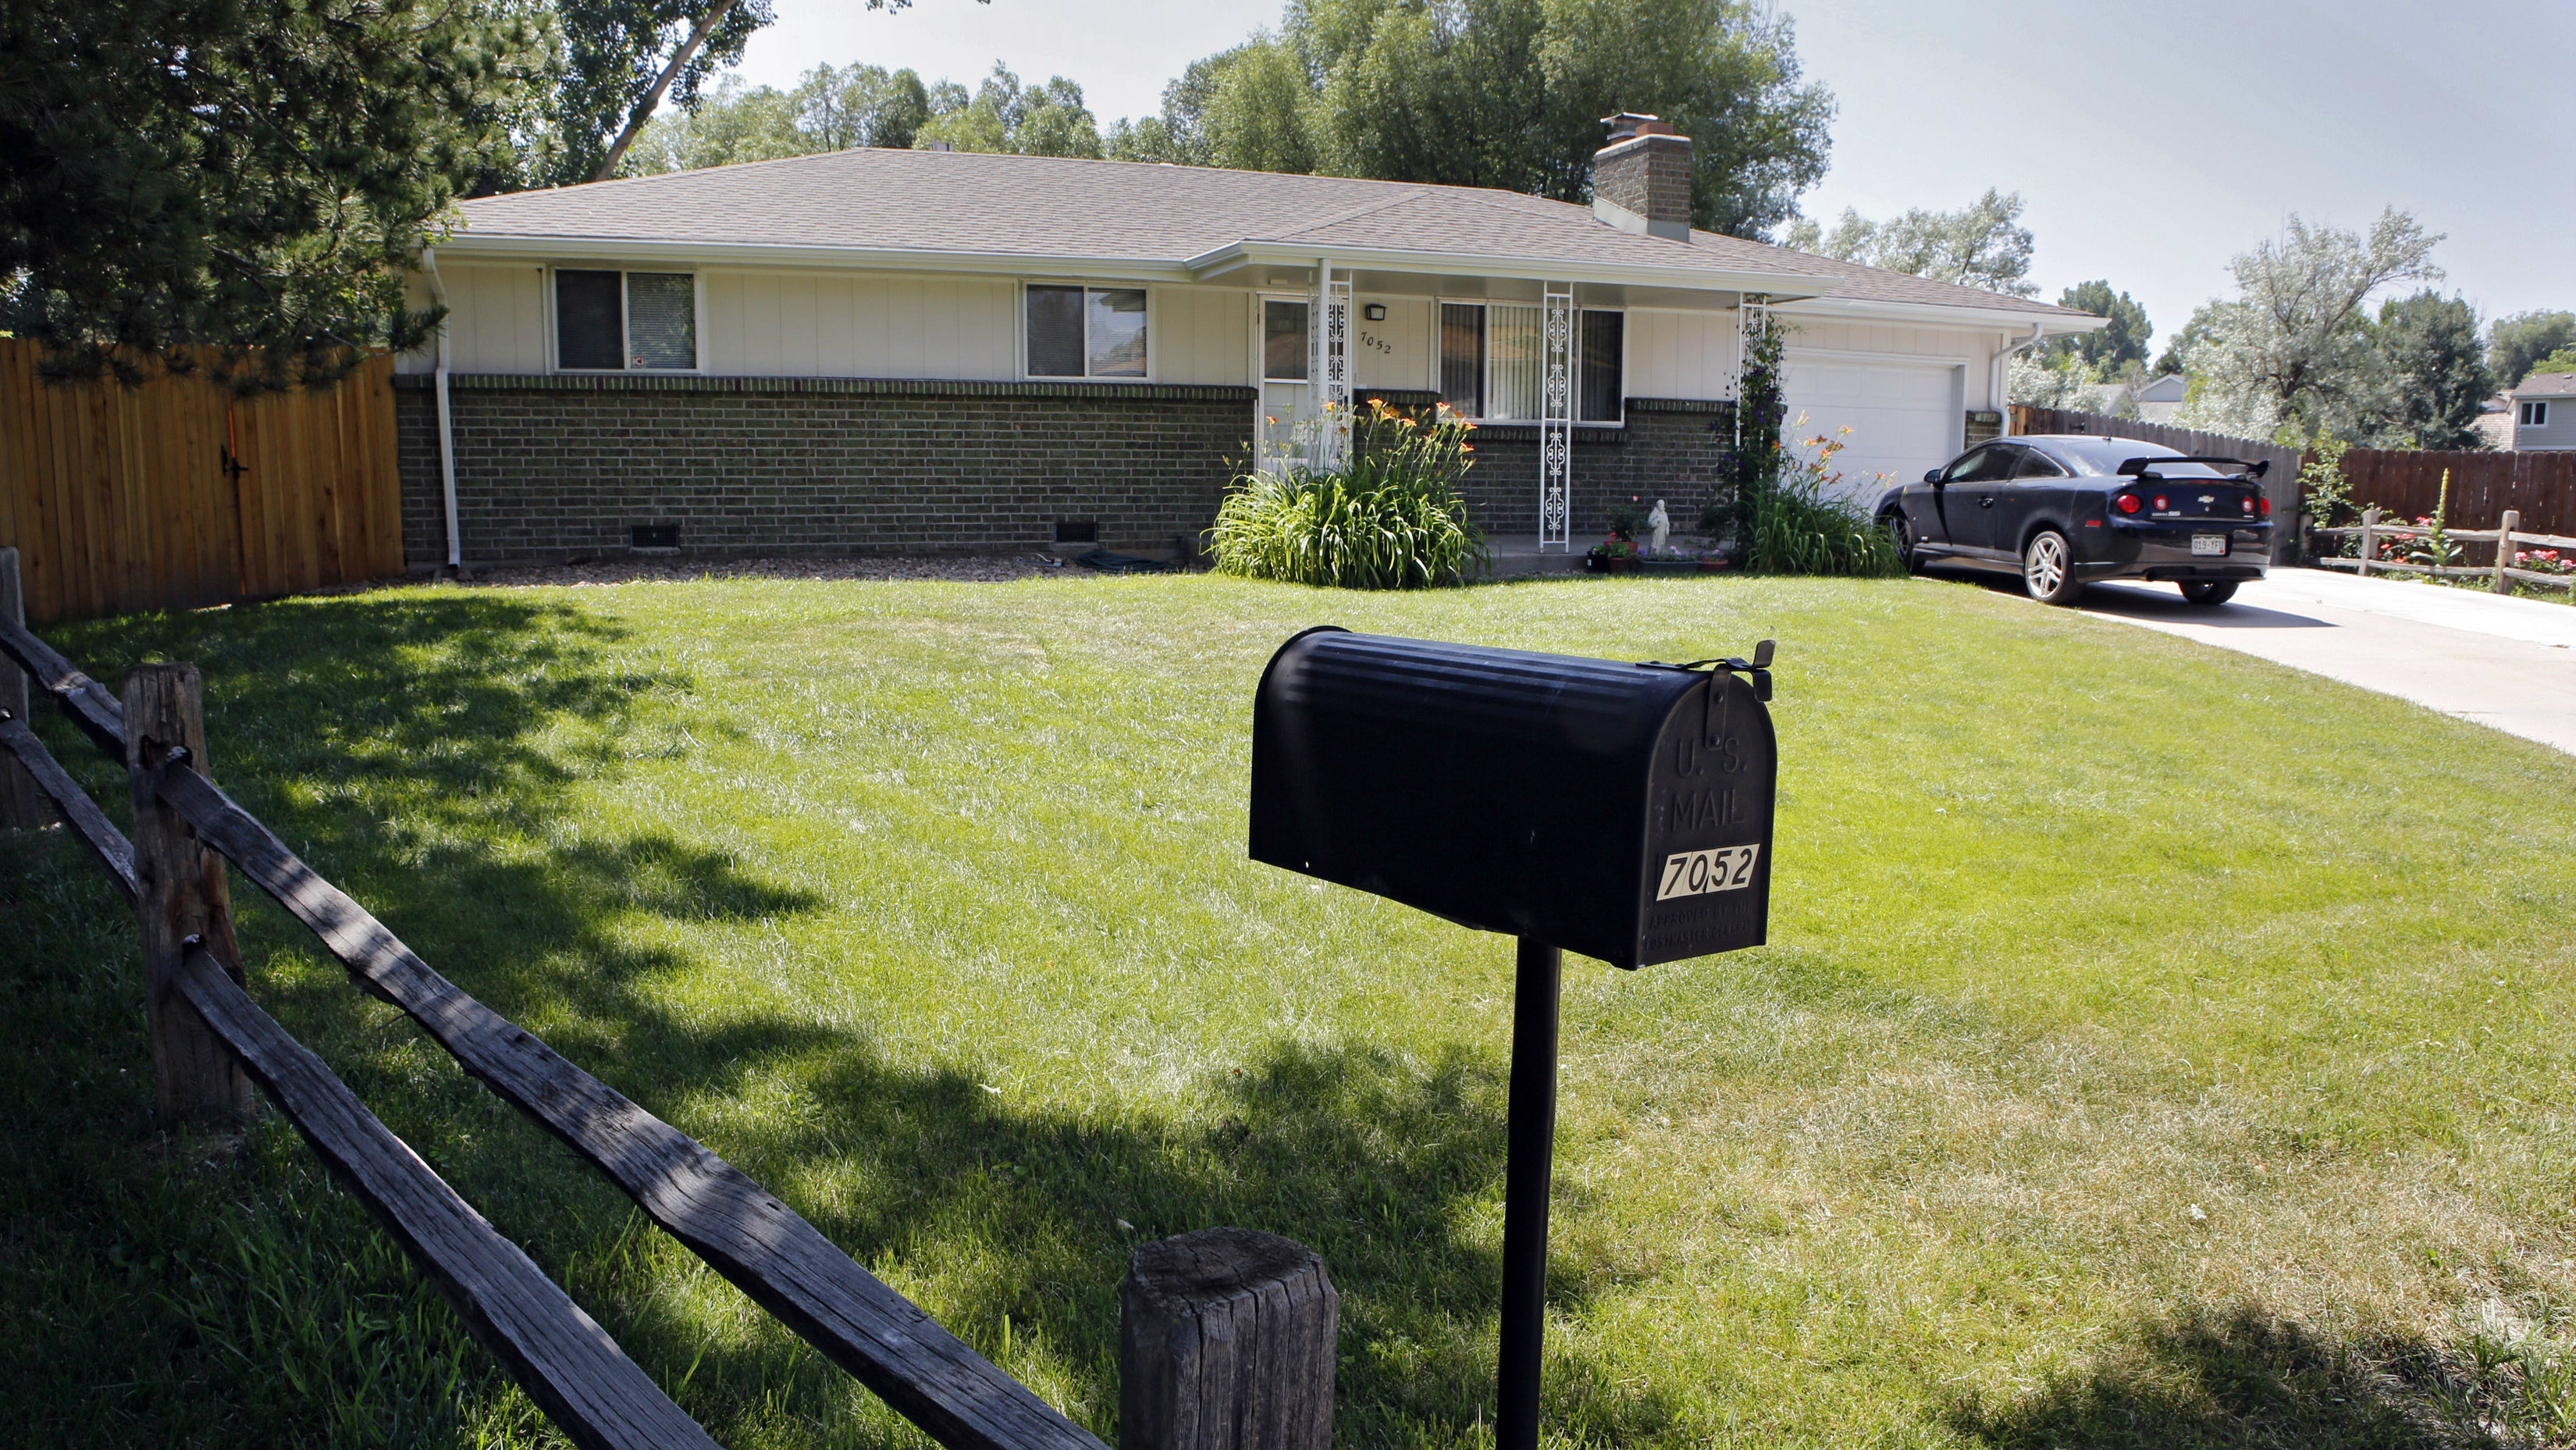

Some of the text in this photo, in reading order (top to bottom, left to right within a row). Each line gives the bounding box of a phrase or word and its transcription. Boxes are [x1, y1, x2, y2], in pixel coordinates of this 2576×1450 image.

[1361, 331, 1391, 354] 7052
[1671, 788, 1745, 832] MAIL
[1663, 848, 1752, 896] 7052
